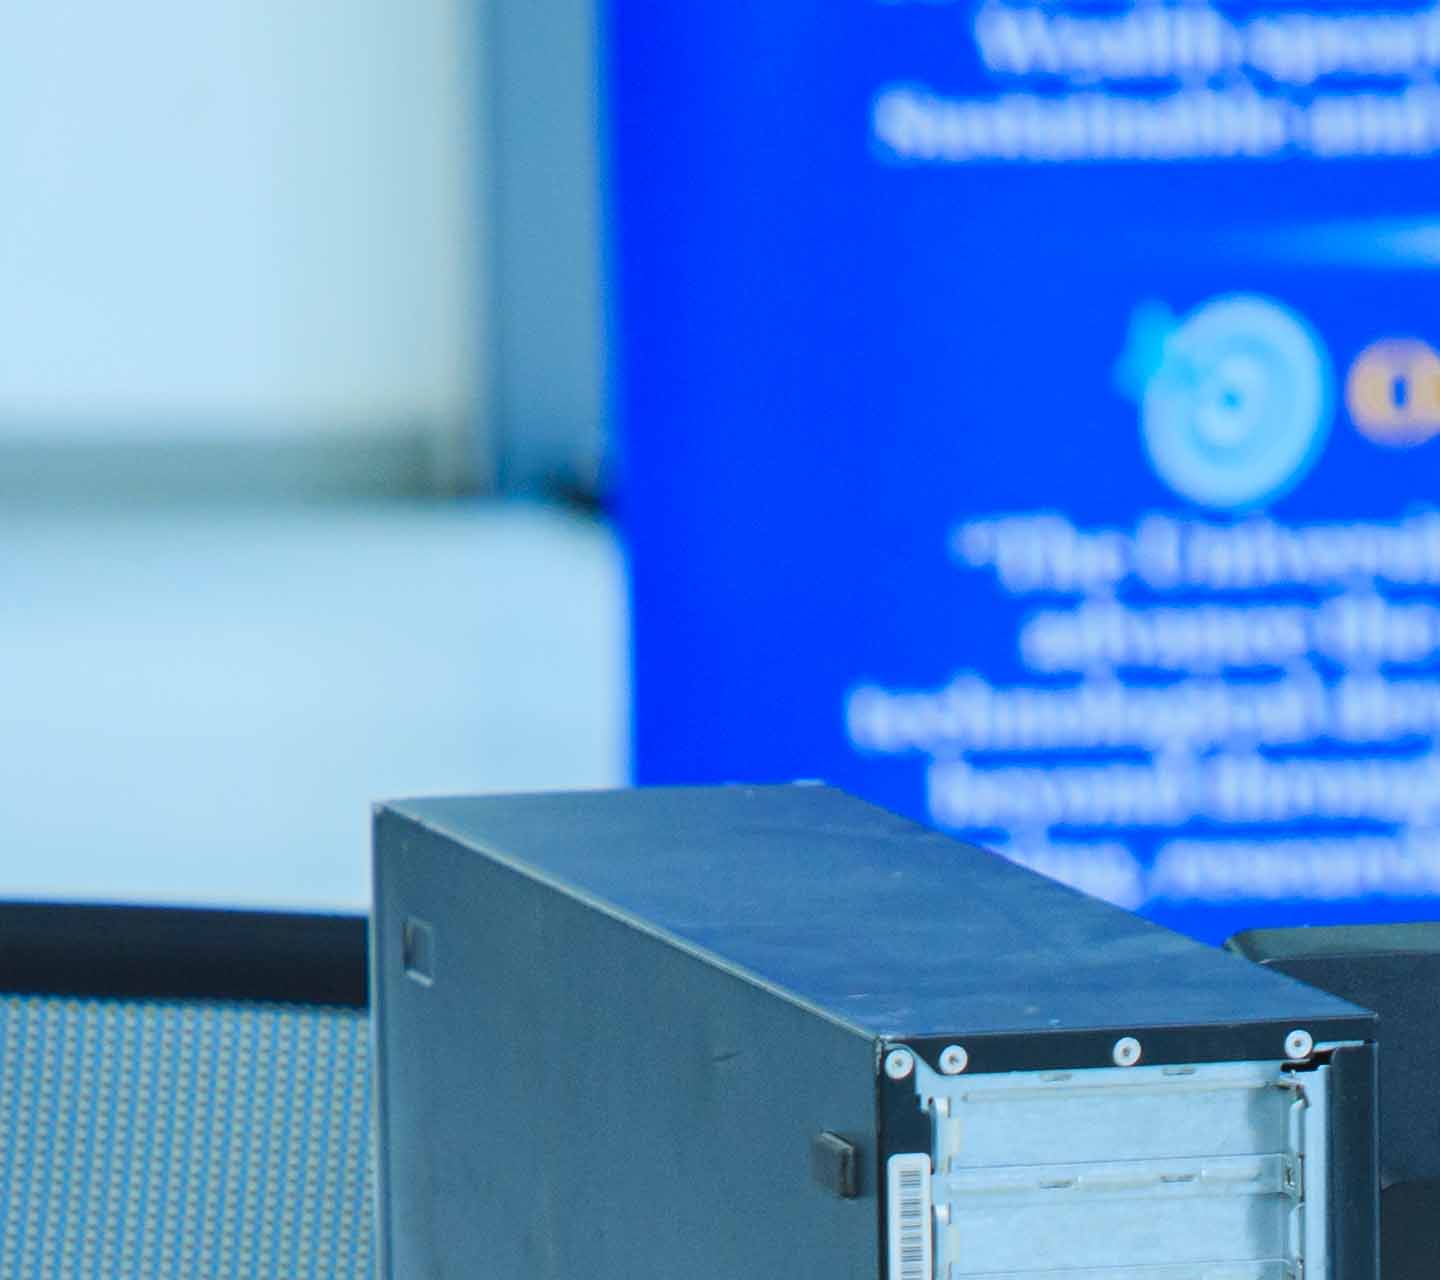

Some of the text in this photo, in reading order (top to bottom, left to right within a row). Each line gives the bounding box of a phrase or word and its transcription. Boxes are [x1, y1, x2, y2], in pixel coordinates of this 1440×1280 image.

[1020, 596, 1308, 674] advance
[1312, 590, 1440, 665] the
[846, 668, 1326, 754] technological
[926, 742, 1194, 830] beyond
